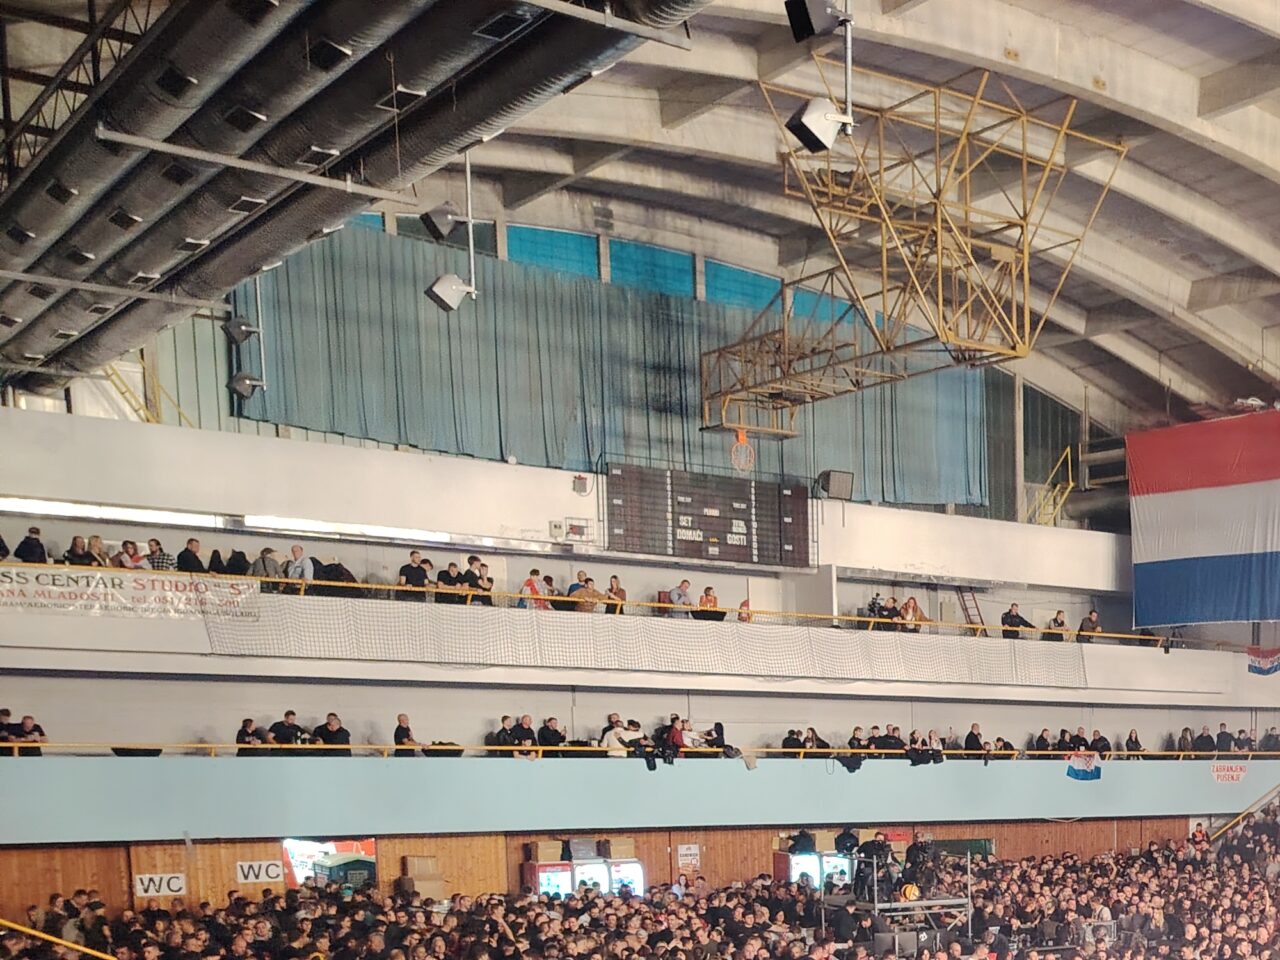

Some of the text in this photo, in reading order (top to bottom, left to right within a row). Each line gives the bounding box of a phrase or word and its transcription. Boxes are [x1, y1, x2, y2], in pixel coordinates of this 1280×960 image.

[727, 534, 747, 546] GOSTI
[35, 573, 124, 590] CENTAR
[133, 578, 208, 594] STUDIO
[34, 589, 115, 602] MLADOSTI
[240, 863, 280, 880] WC
[139, 876, 183, 894] WC
